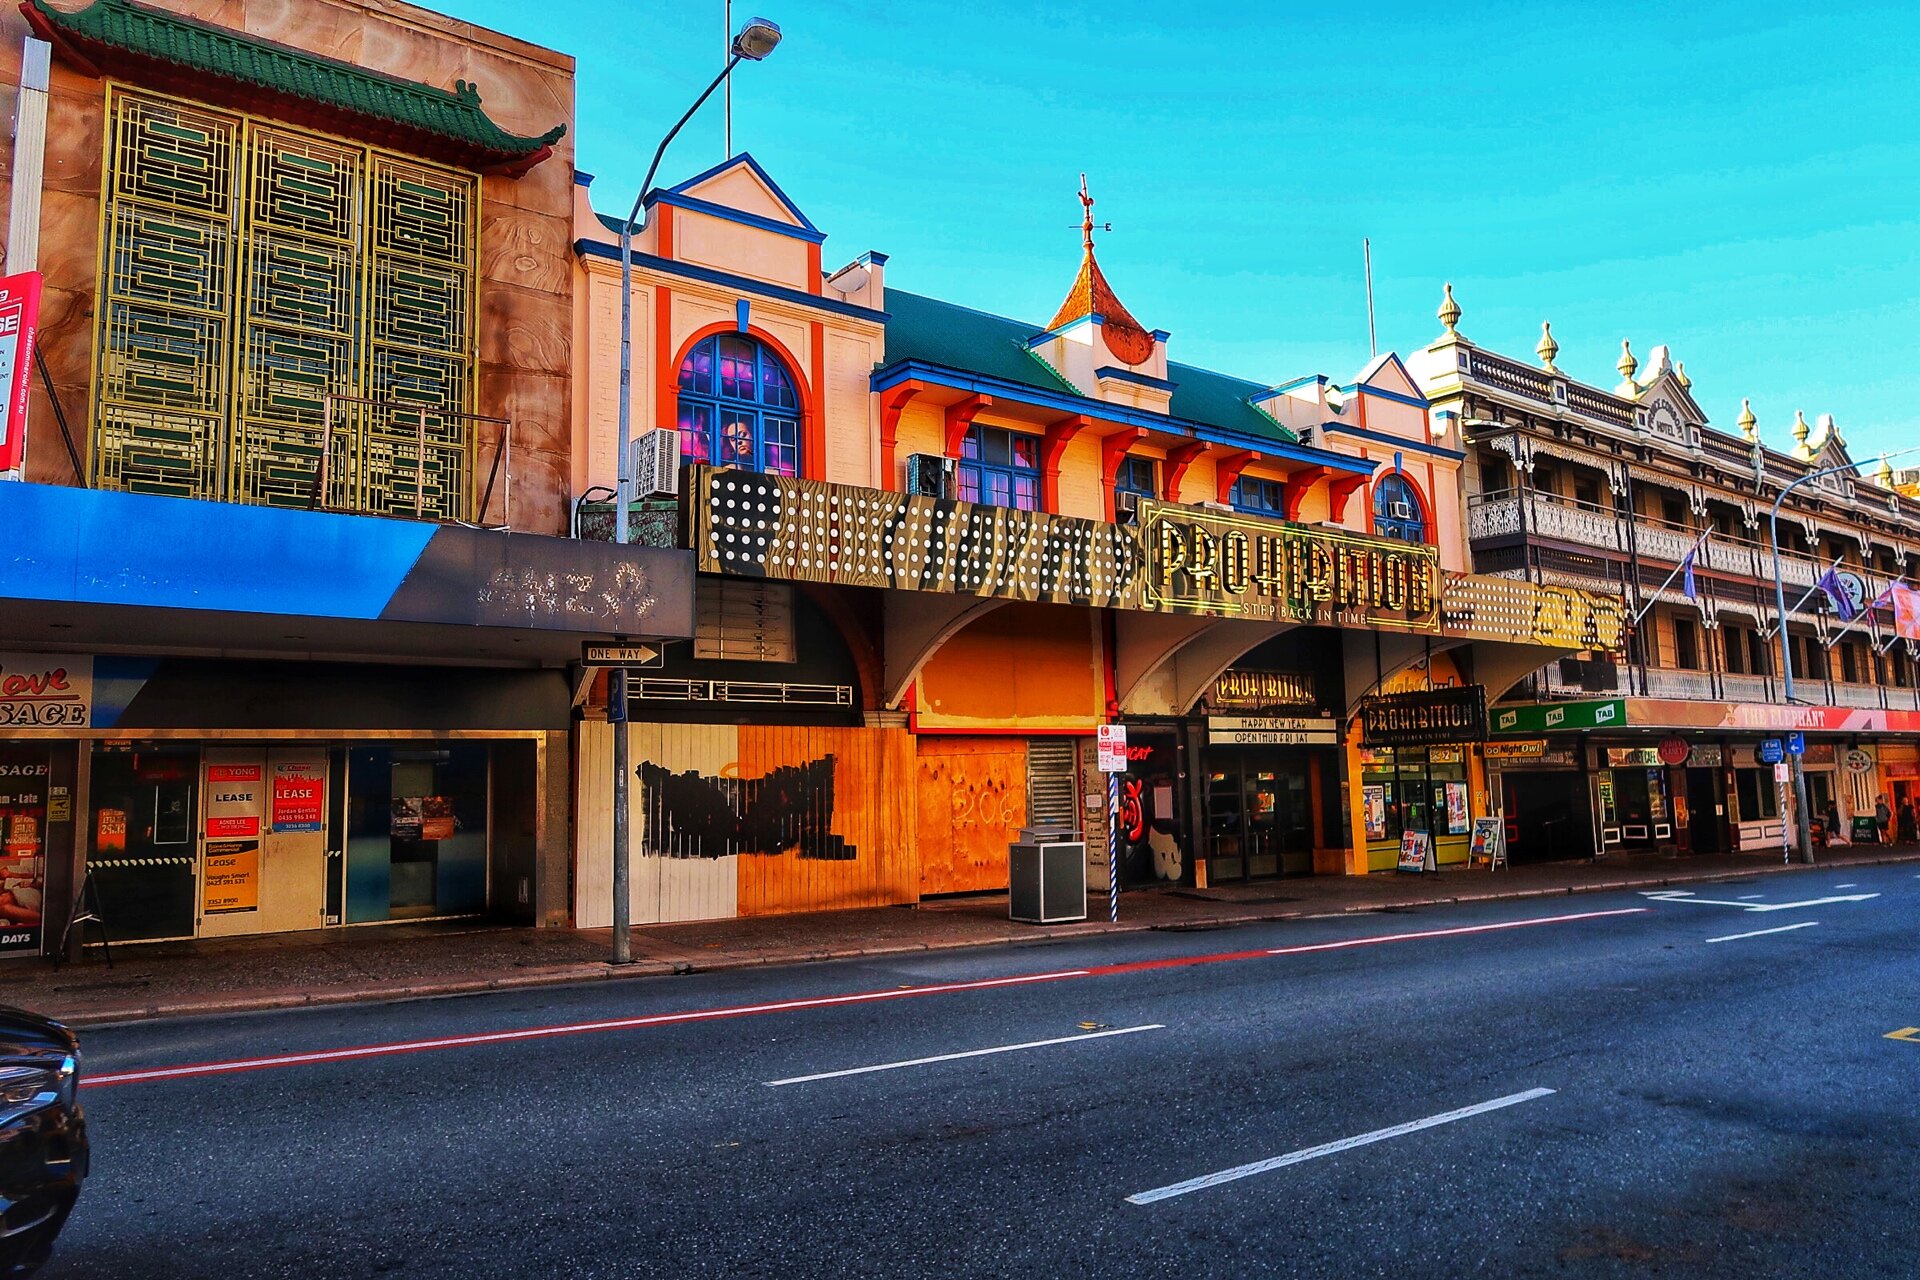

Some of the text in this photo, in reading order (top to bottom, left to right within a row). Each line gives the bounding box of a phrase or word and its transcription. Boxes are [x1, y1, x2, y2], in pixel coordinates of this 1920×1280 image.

[1656, 420, 1675, 437] HOTEL
[1159, 518, 1431, 613] PROHIBITION
[1243, 602, 1367, 625] STEP BACK IN TIME
[590, 649, 640, 659] ONE WAY
[0, 664, 71, 695] ove
[1221, 672, 1313, 698] PROHIBITION
[1369, 703, 1473, 732] PROHIBITION
[1743, 707, 1825, 727] THE ELEPHANT
[1241, 719, 1267, 730] HAPPY
[1269, 719, 1286, 729] NEW
[1235, 733, 1257, 743] OPEN
[1790, 733, 1798, 743] P
[0, 764, 46, 776] SAGE
[228, 768, 255, 777] YONG
[19, 793, 38, 804] Late
[215, 794, 253, 802] LEASE
[276, 789, 313, 799] LEASE
[952, 789, 1014, 824] 206
[207, 859, 236, 867] Lease
[1, 934, 31, 944] DAYS
